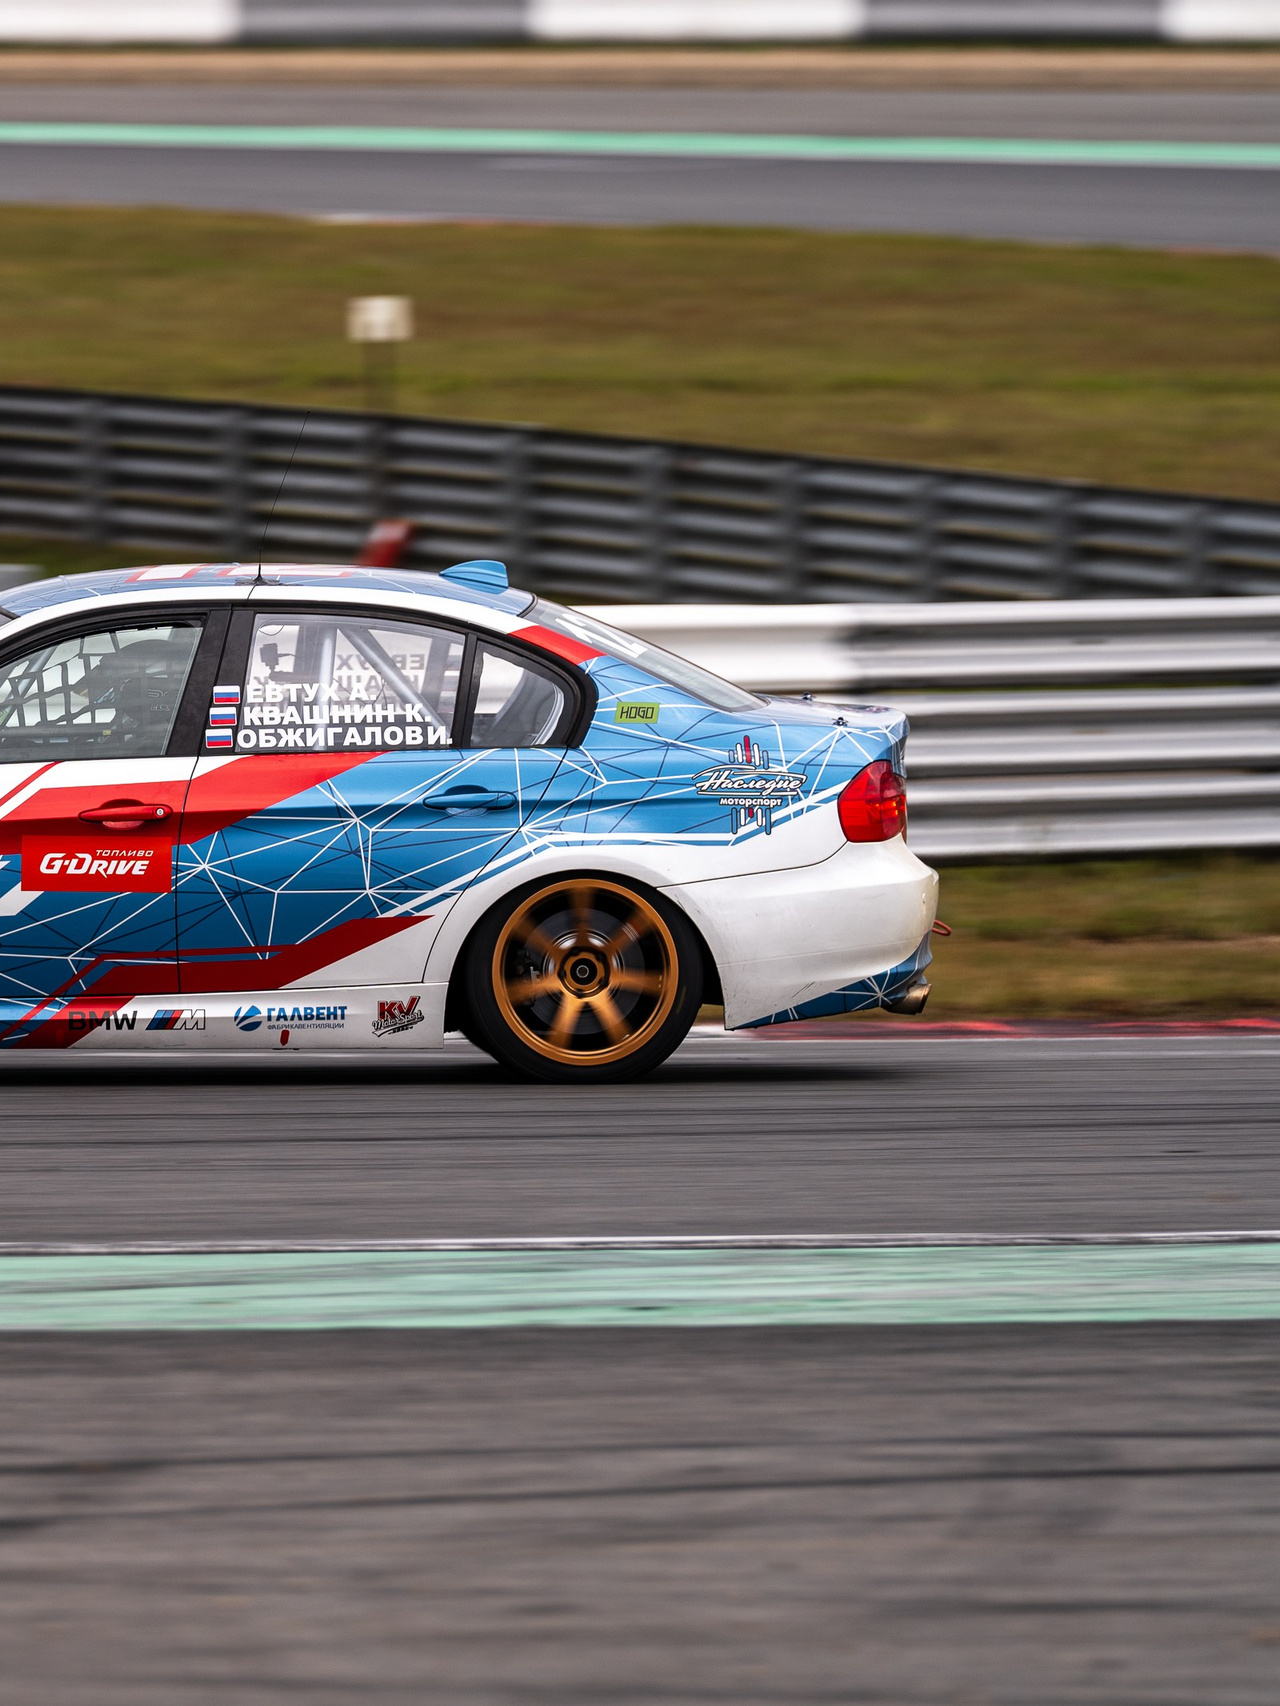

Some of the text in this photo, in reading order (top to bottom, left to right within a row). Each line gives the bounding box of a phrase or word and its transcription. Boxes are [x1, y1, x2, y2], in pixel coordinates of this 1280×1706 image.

[246, 683, 340, 703] ЕВТУХ
[349, 682, 377, 701] А.
[244, 703, 432, 726] КВАШНИН К.
[620, 706, 655, 719] HOGO
[695, 769, 803, 796] Наследие
[96, 849, 154, 857] ТОПЛИВО
[267, 1006, 347, 1022] ГАЛВЕНТ
[377, 996, 421, 1020] KV
[68, 1010, 138, 1031] BMW
